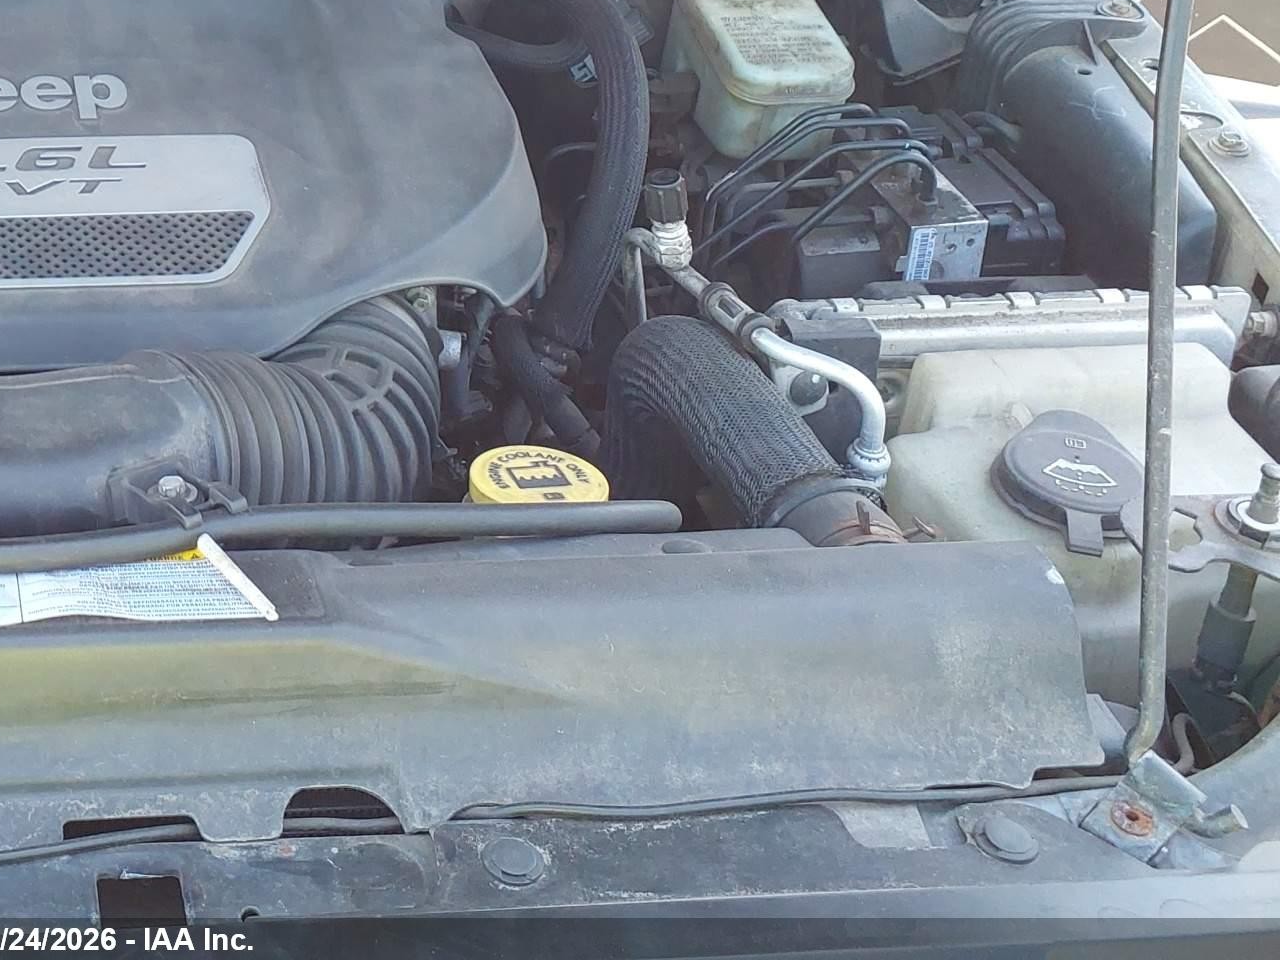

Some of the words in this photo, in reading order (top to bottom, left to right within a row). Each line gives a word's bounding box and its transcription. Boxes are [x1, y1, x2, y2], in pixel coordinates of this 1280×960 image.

[497, 451, 565, 463] COOLANT
[487, 461, 511, 489] ENGINE
[566, 463, 590, 484] ONLY
